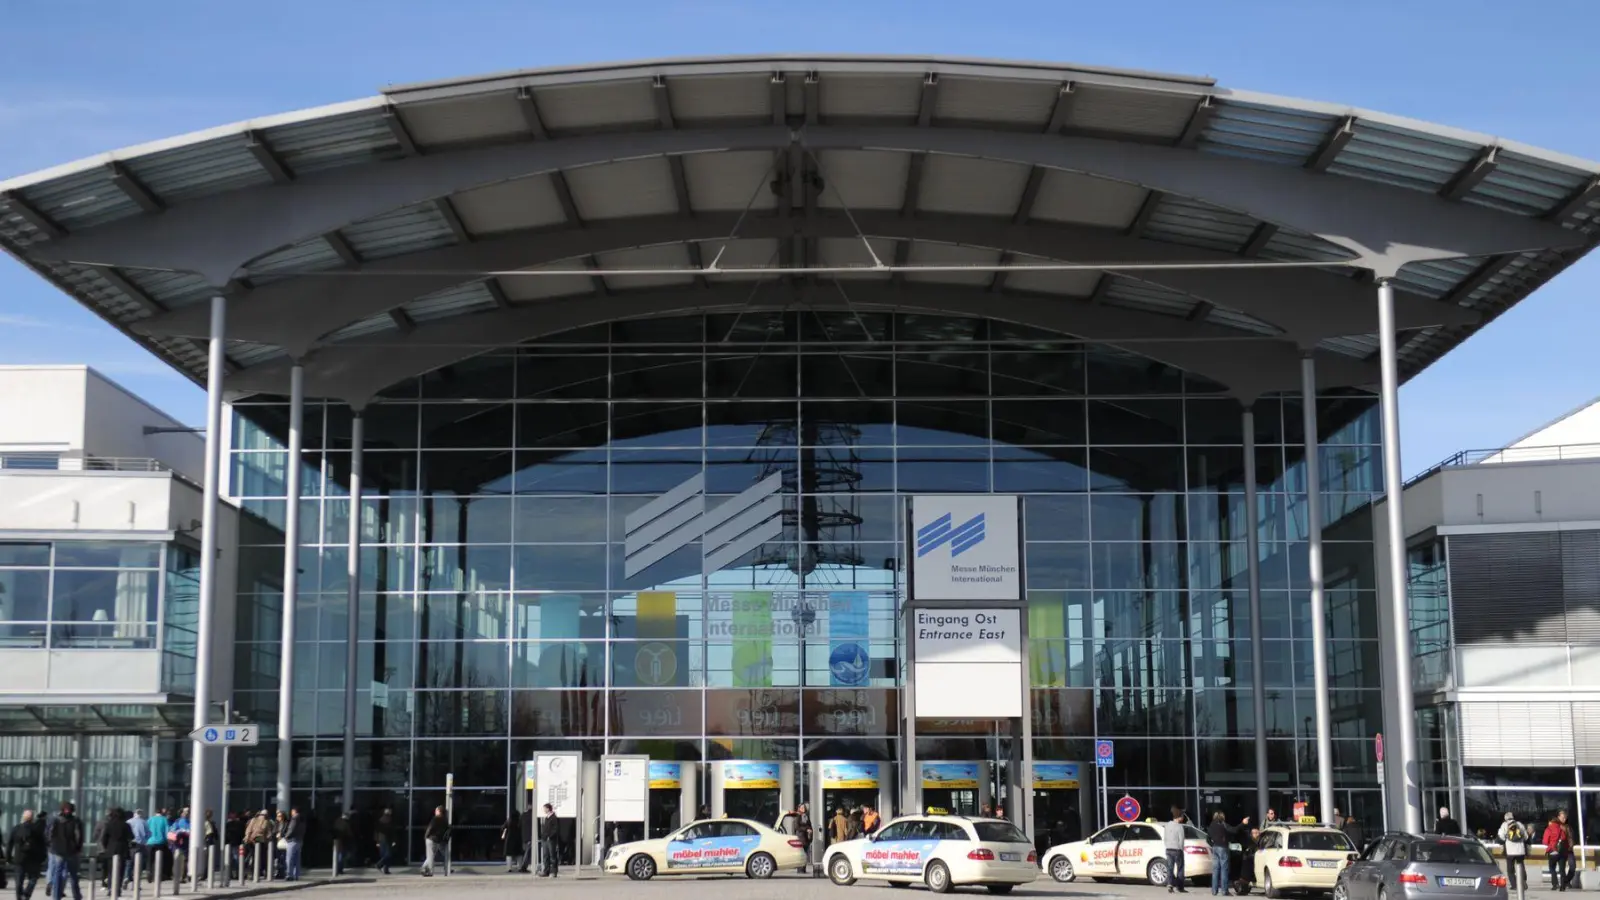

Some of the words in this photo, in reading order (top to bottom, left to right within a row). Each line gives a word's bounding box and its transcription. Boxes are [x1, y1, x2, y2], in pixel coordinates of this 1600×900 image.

[951, 565, 977, 574] Messe
[978, 564, 1016, 574] München
[951, 575, 1003, 584] International
[918, 613, 969, 627] Eingang
[975, 613, 997, 625] Ost
[918, 628, 973, 640] Entrance
[978, 628, 1006, 640] East
[241, 728, 250, 742] 2
[672, 848, 702, 859] möbel
[865, 849, 889, 860] möbel
